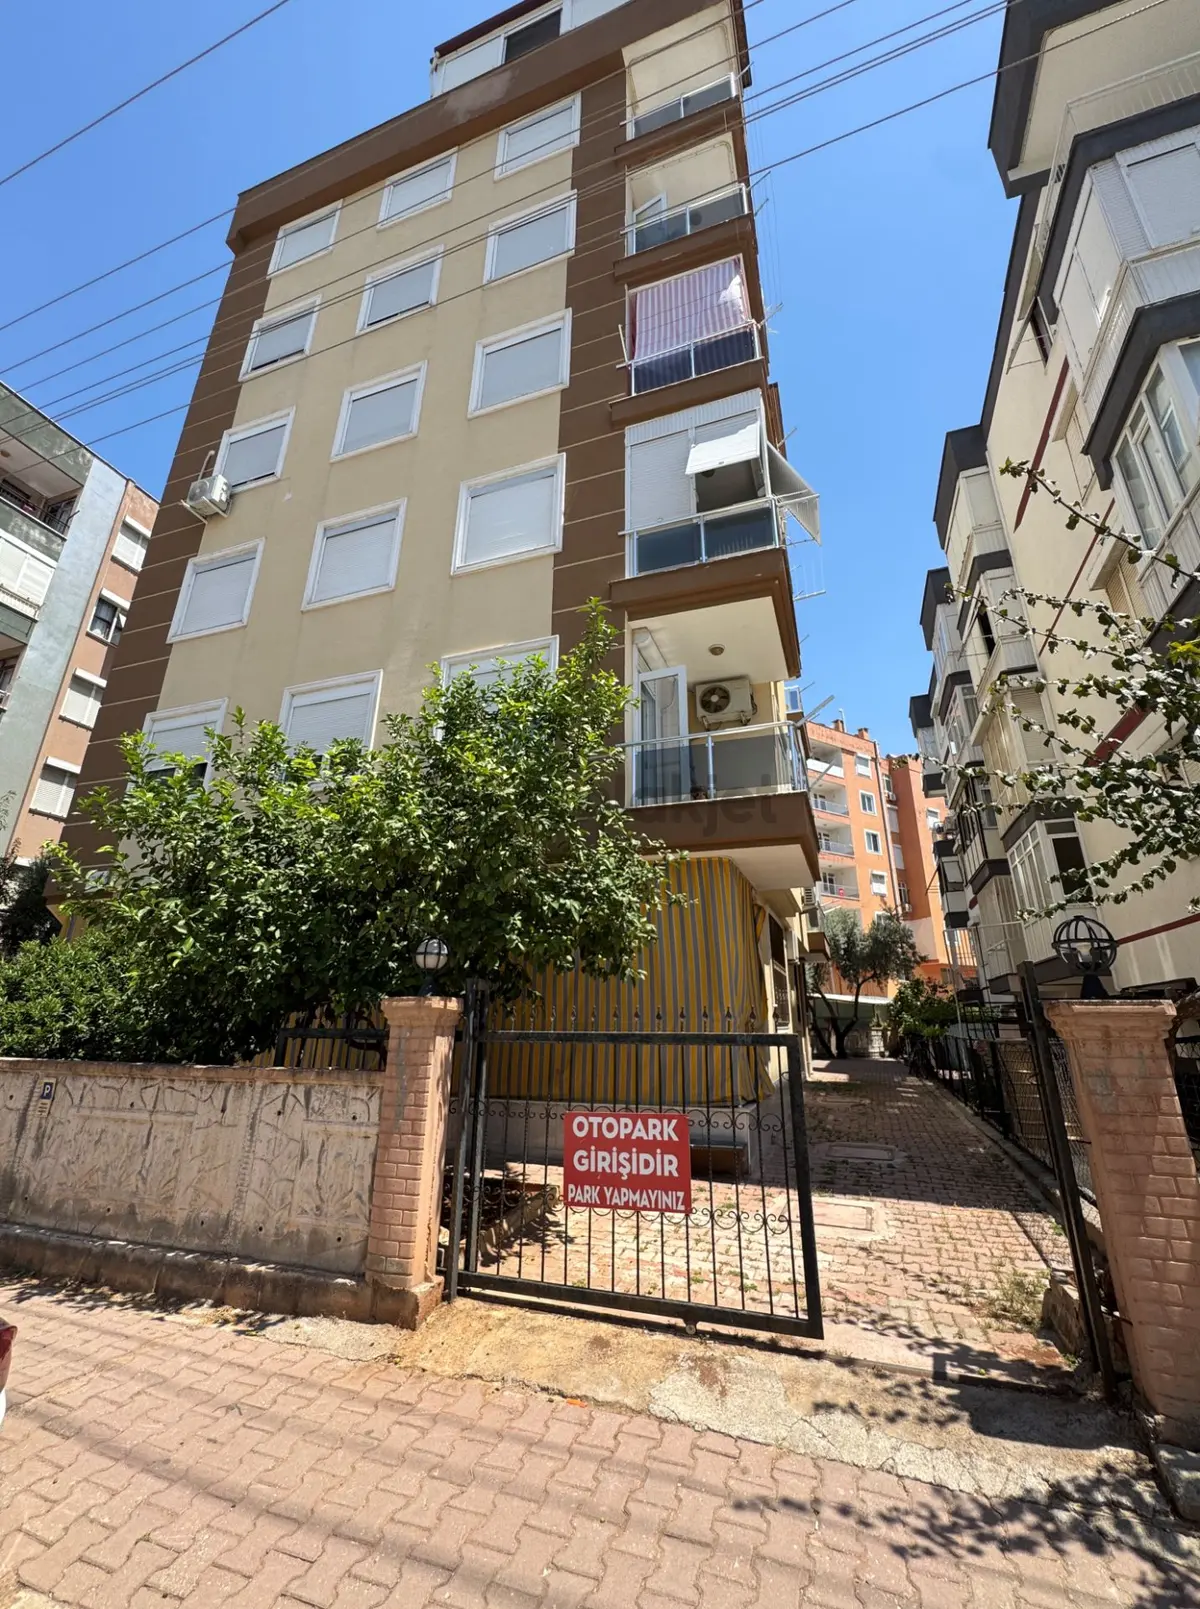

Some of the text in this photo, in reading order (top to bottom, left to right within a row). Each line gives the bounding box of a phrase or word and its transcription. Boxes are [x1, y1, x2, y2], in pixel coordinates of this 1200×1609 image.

[43, 1084, 51, 1097] P
[572, 1115, 679, 1141] OTOPARK
[573, 1145, 679, 1180] GİRİŞİDİR
[568, 1183, 685, 1211] PARK YAPMAYINIZ
